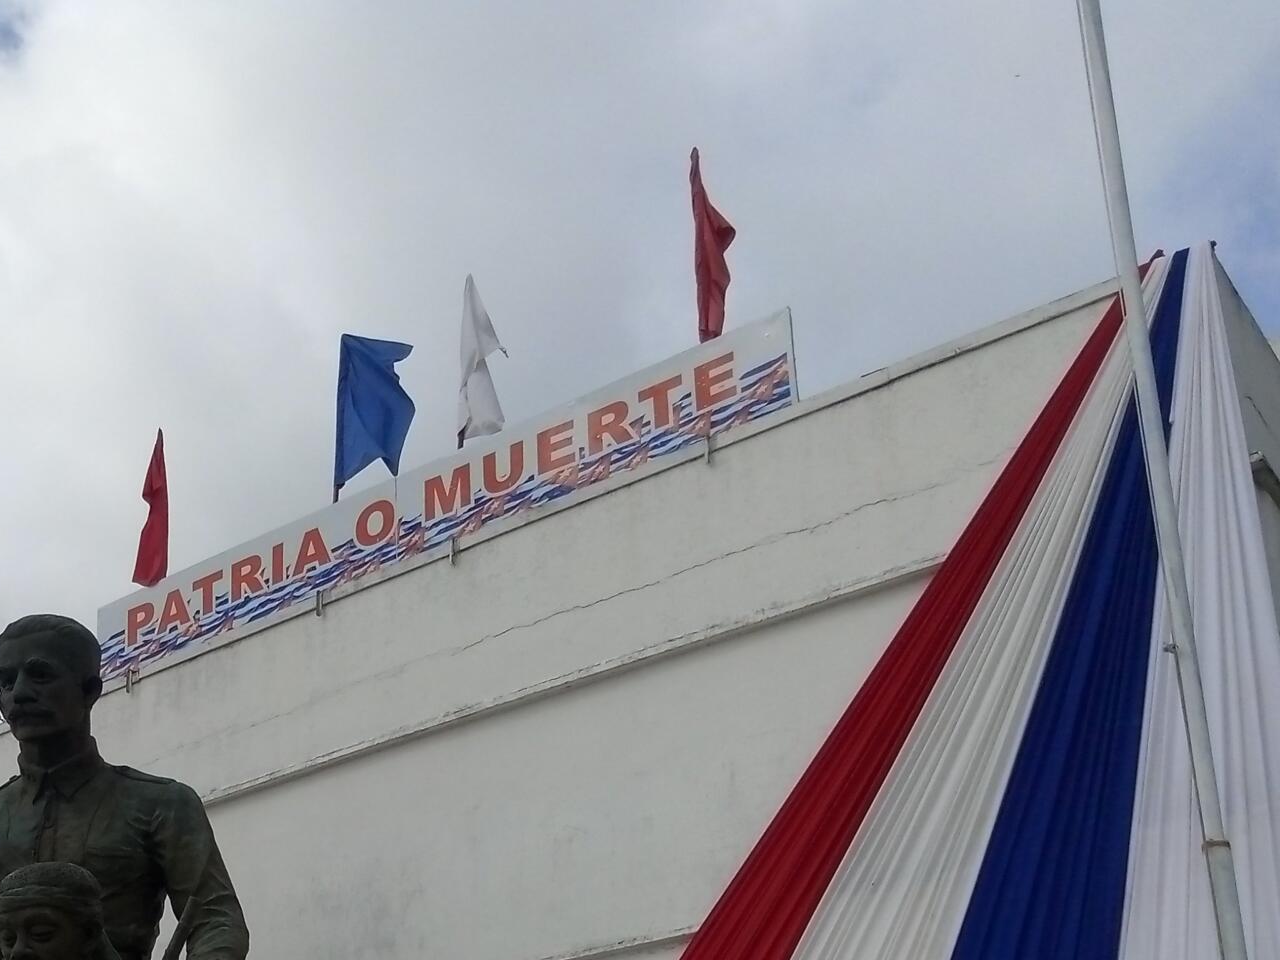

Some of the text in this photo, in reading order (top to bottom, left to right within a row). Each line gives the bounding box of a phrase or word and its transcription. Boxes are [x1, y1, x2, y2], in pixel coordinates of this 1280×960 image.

[126, 351, 738, 647] PATRIA O MUERTE
